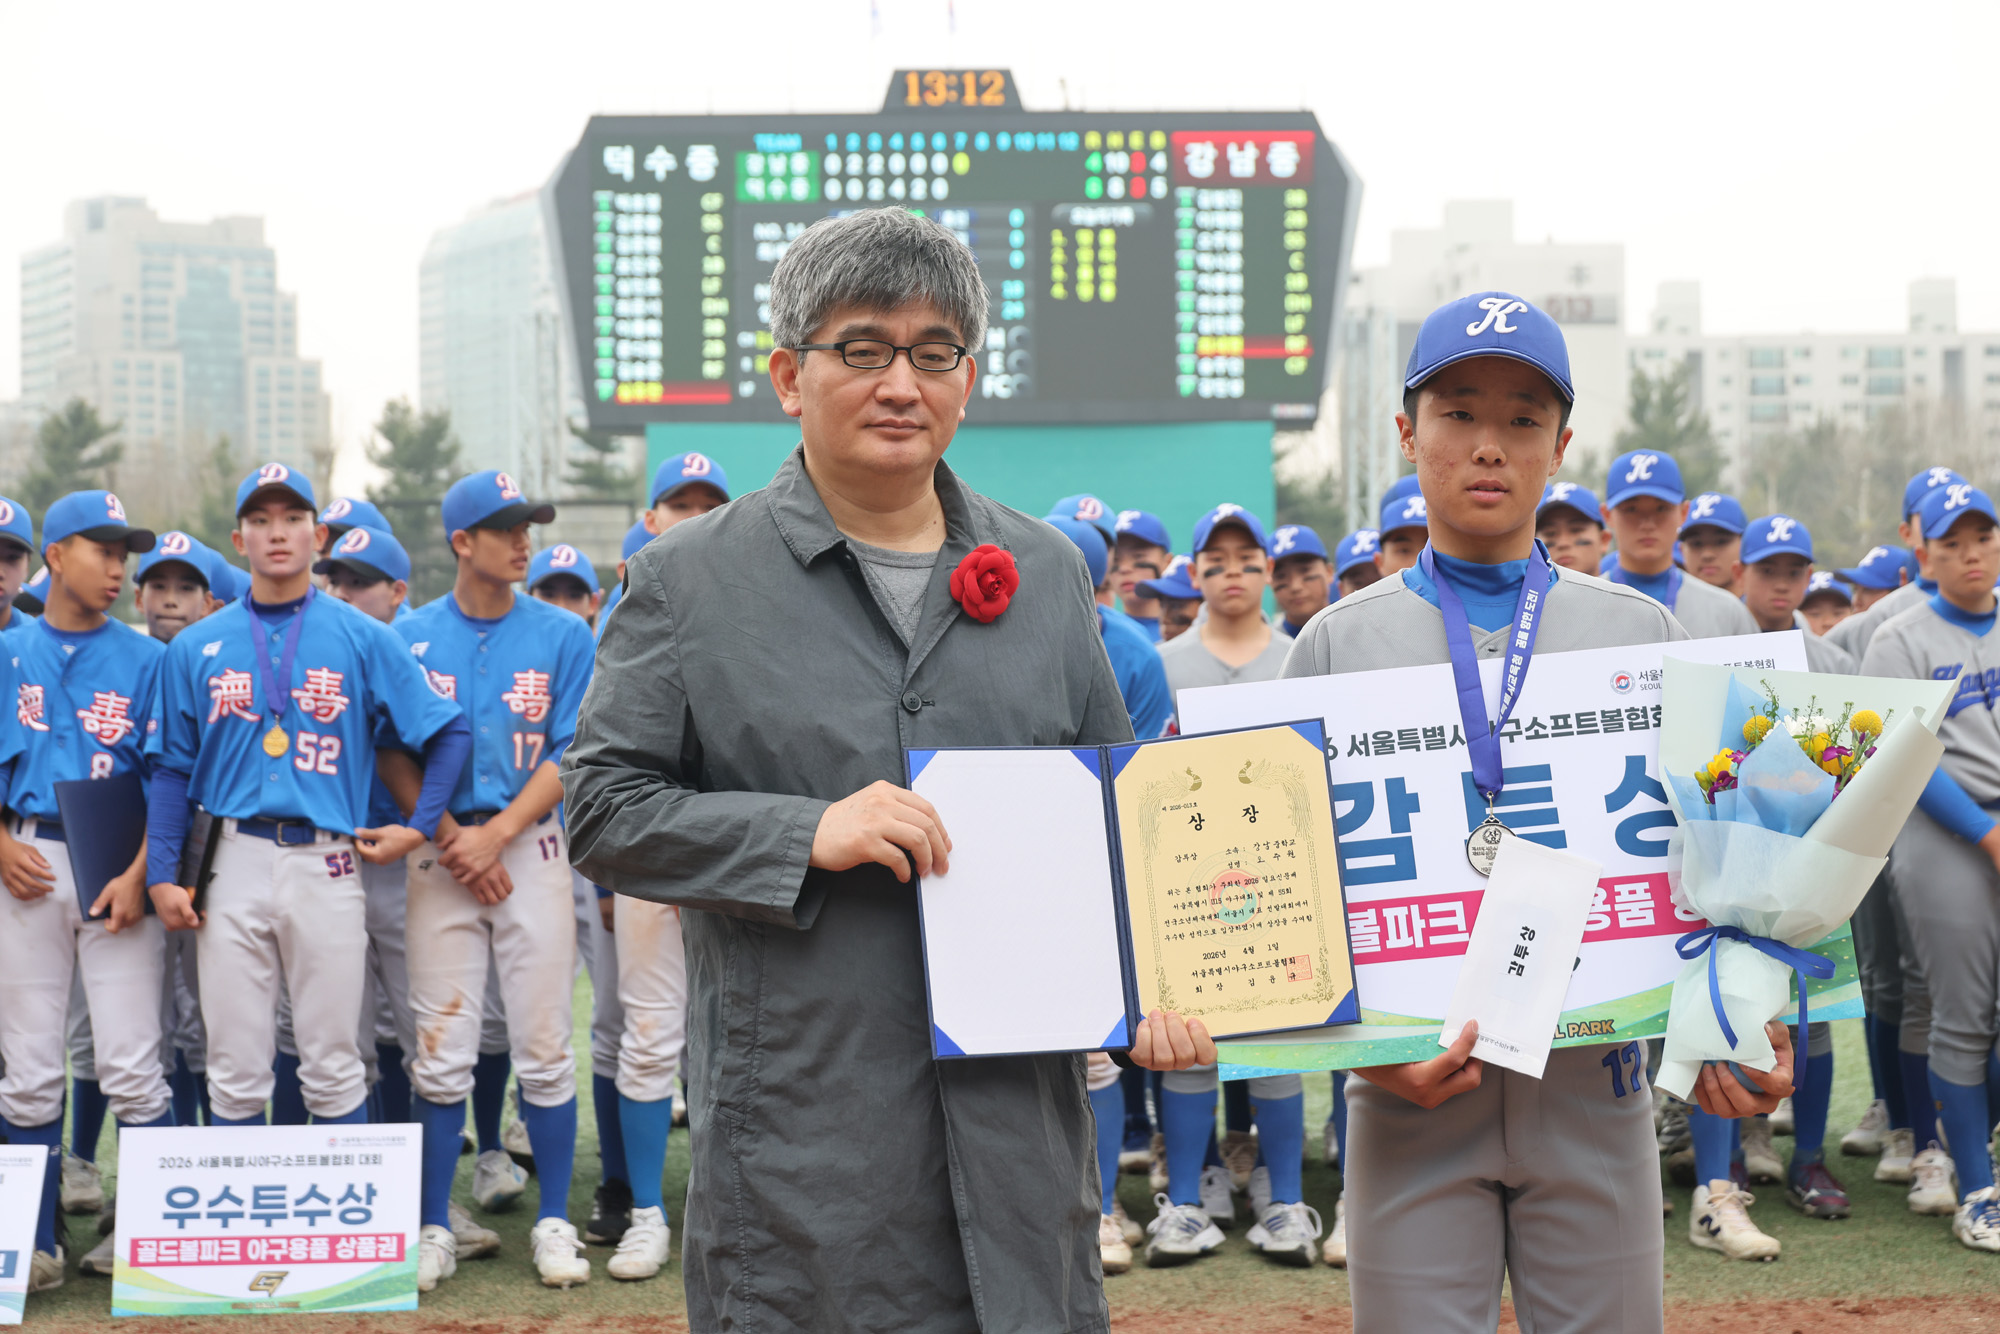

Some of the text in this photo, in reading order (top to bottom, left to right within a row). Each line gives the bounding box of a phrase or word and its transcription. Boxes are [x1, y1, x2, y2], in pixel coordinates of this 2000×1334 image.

[904, 70, 1005, 107] 13:12
[825, 131, 838, 152] 1
[889, 131, 904, 152] 4
[954, 131, 968, 152] 7
[824, 152, 842, 176] 0
[845, 152, 863, 176] 2
[867, 152, 885, 176] 2
[888, 152, 906, 176] 0
[909, 152, 928, 176] 0
[930, 152, 949, 176] 0
[952, 152, 970, 176] 0
[1085, 151, 1103, 174] 4
[1150, 151, 1168, 174] 4
[824, 176, 842, 200] 0
[845, 176, 863, 200] 0
[867, 176, 885, 200] 2
[888, 176, 906, 200] 4
[909, 176, 928, 200] 2
[930, 176, 949, 200] 0
[1466, 297, 1528, 337] K
[257, 462, 289, 487] D
[681, 452, 711, 477] D
[1625, 454, 1659, 484] K
[1927, 466, 1952, 488] K
[496, 472, 520, 499] D
[1943, 484, 1973, 510] K
[323, 498, 352, 522] D
[1075, 497, 1104, 521] D
[1691, 494, 1721, 520] K
[339, 527, 371, 553] D
[1273, 527, 1299, 554] K
[1351, 530, 1380, 556] K
[1766, 517, 1797, 543] K
[159, 531, 191, 556] D
[550, 544, 578, 568] D
[1519, 611, 1534, 630] 향한
[1515, 631, 1530, 649] 꿈을
[294, 730, 342, 775] 52
[513, 732, 546, 770] 17
[1187, 804, 1260, 832] 상 장
[539, 834, 559, 861] 17
[324, 850, 354, 878] 52
[1243, 877, 1259, 886] 2026
[1203, 942, 1279, 960] 2026년 4월 1일
[1507, 925, 1536, 977] 감투상
[1567, 1019, 1615, 1037] PARK
[1602, 1040, 1642, 1098] 17
[158, 1156, 193, 1169] 2026
[359, 1152, 383, 1167] 대회
[162, 1182, 378, 1229] 우수투수상
[137, 1235, 398, 1263] 골드볼파크 야구용품 상품권
